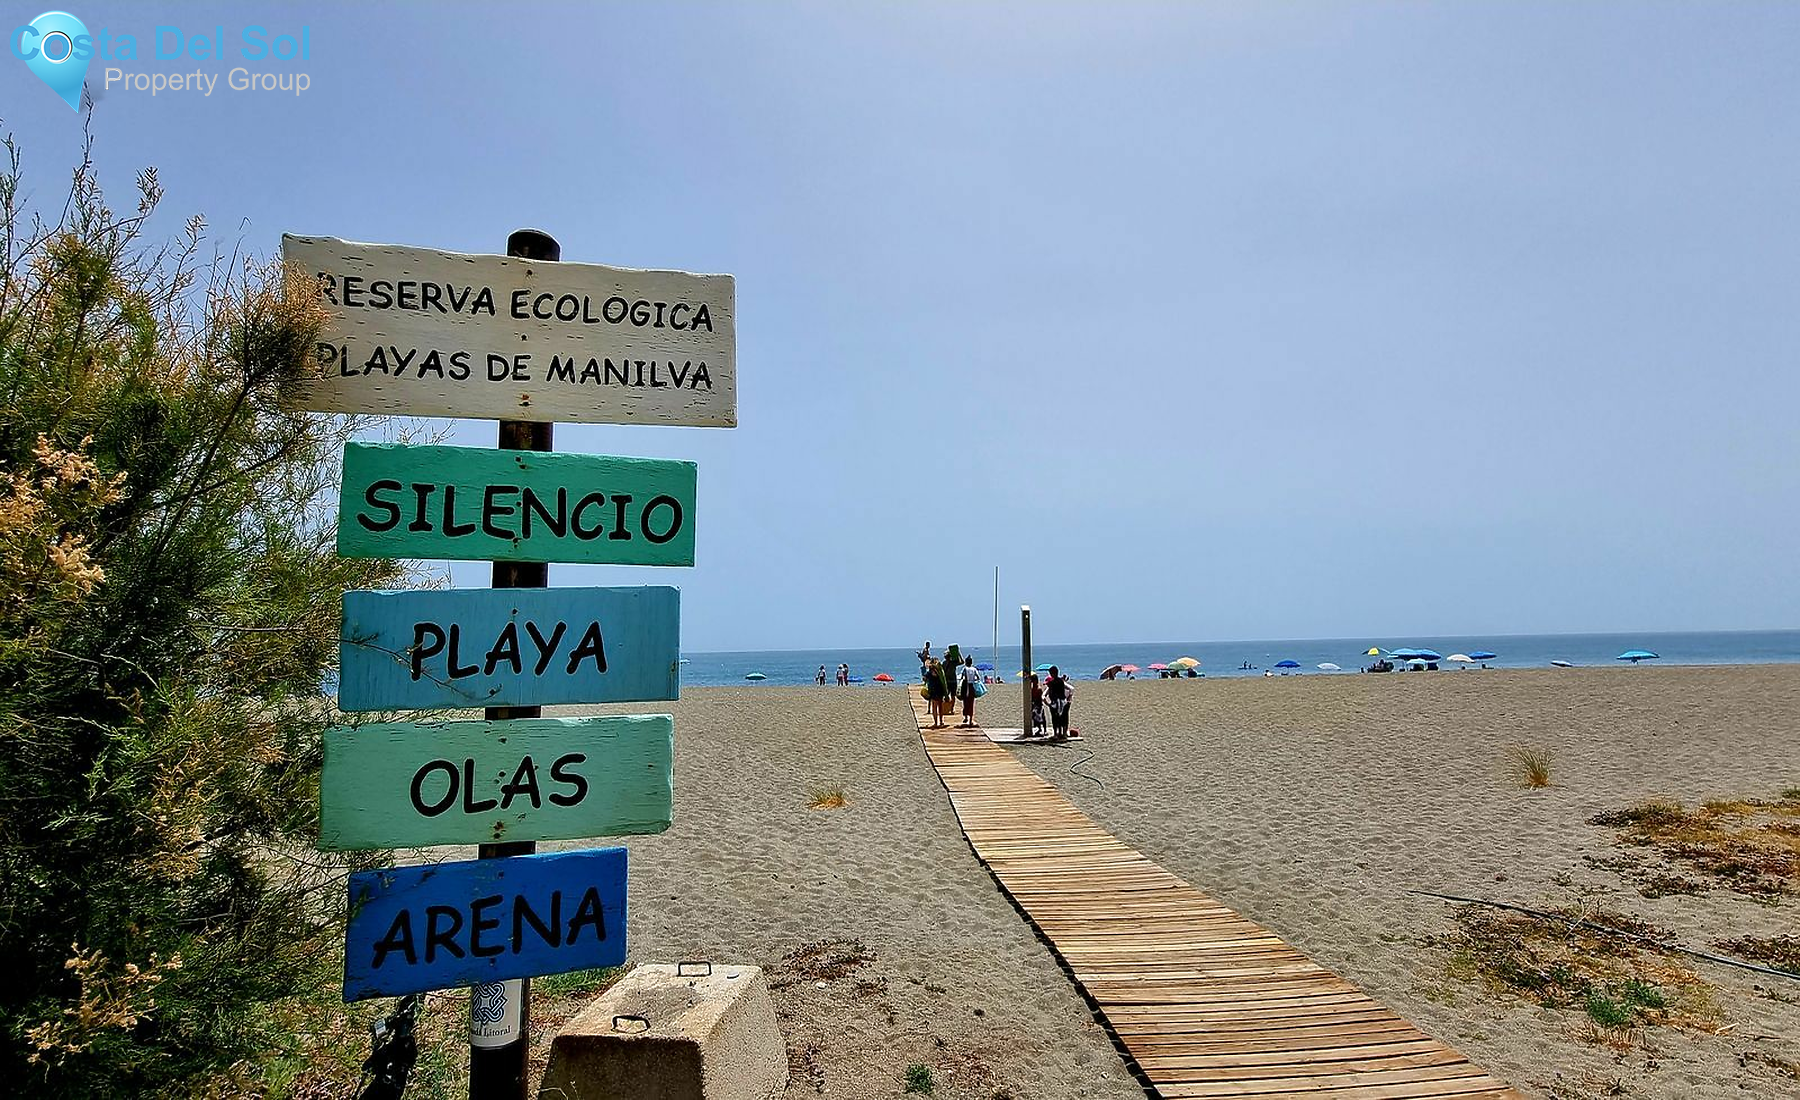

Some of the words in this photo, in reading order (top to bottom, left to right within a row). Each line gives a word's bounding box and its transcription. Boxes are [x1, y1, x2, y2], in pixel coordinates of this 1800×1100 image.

[316, 272, 496, 316] RESERVA
[510, 289, 713, 332] ECOLOGICA
[315, 342, 472, 381] PLAYAS
[487, 354, 531, 382] DE
[546, 355, 713, 390] MANILVA
[357, 479, 684, 544] SILENCIO
[410, 621, 608, 681] PLAYA
[410, 753, 588, 817] OLAS
[371, 887, 606, 969] ARENA
